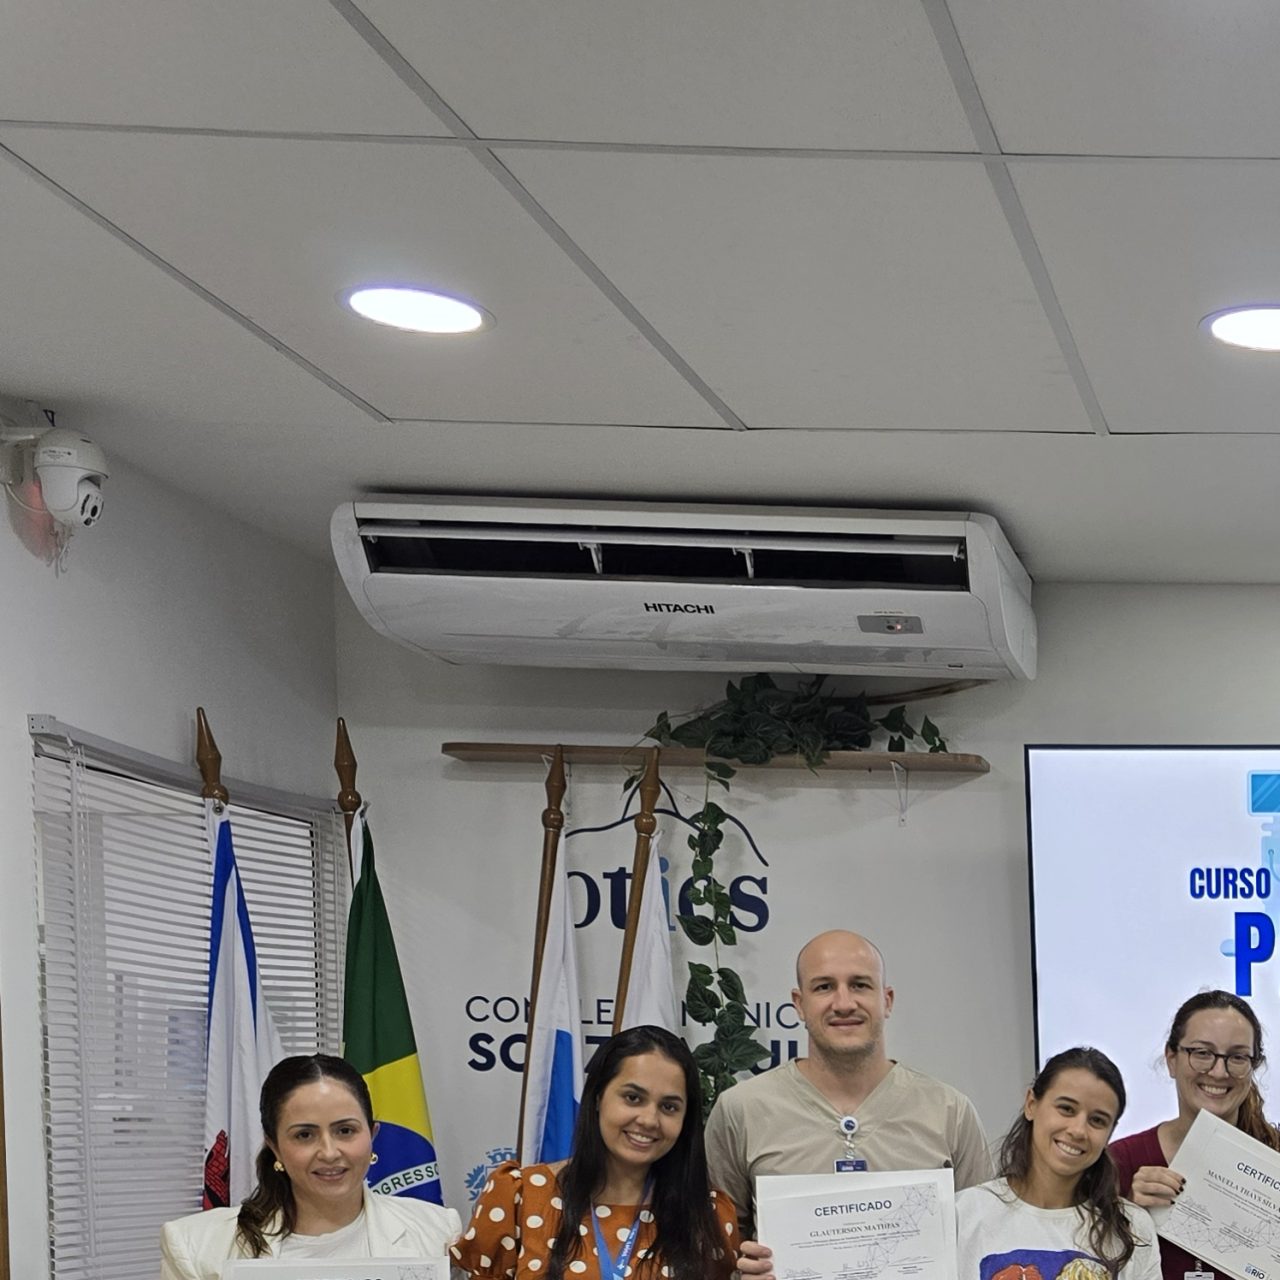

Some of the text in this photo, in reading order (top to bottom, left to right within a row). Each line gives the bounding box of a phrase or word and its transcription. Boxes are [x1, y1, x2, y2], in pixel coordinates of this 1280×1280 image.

[643, 602, 715, 614] HITACHI
[1190, 867, 1271, 899] CURSO
[814, 1200, 893, 1218] CERTIFICADO
[1250, 1268, 1265, 1280] RIO
